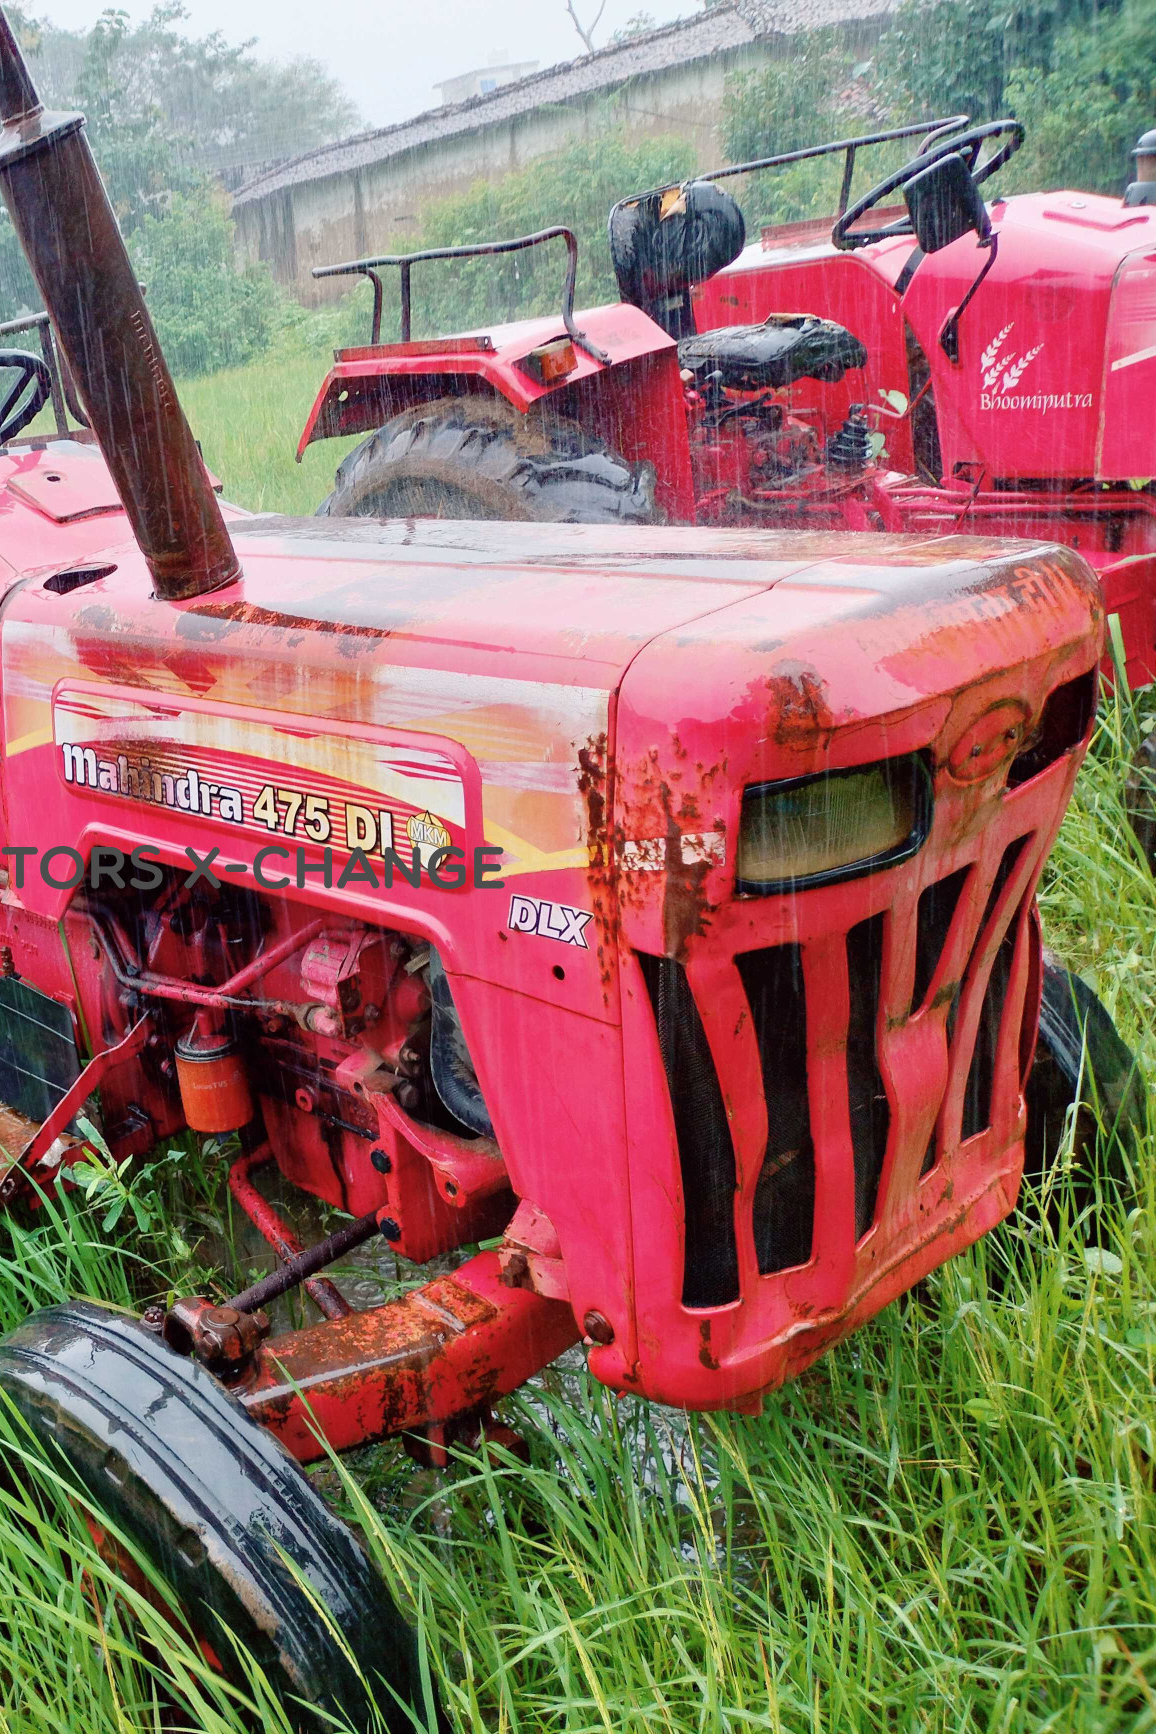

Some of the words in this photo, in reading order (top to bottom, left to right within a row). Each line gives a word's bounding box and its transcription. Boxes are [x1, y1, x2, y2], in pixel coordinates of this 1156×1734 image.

[979, 390, 1093, 416] Bhoomiputra
[253, 785, 331, 844] 475
[345, 803, 395, 858] DI
[410, 818, 448, 848] MKM
[508, 896, 594, 950] DLX
